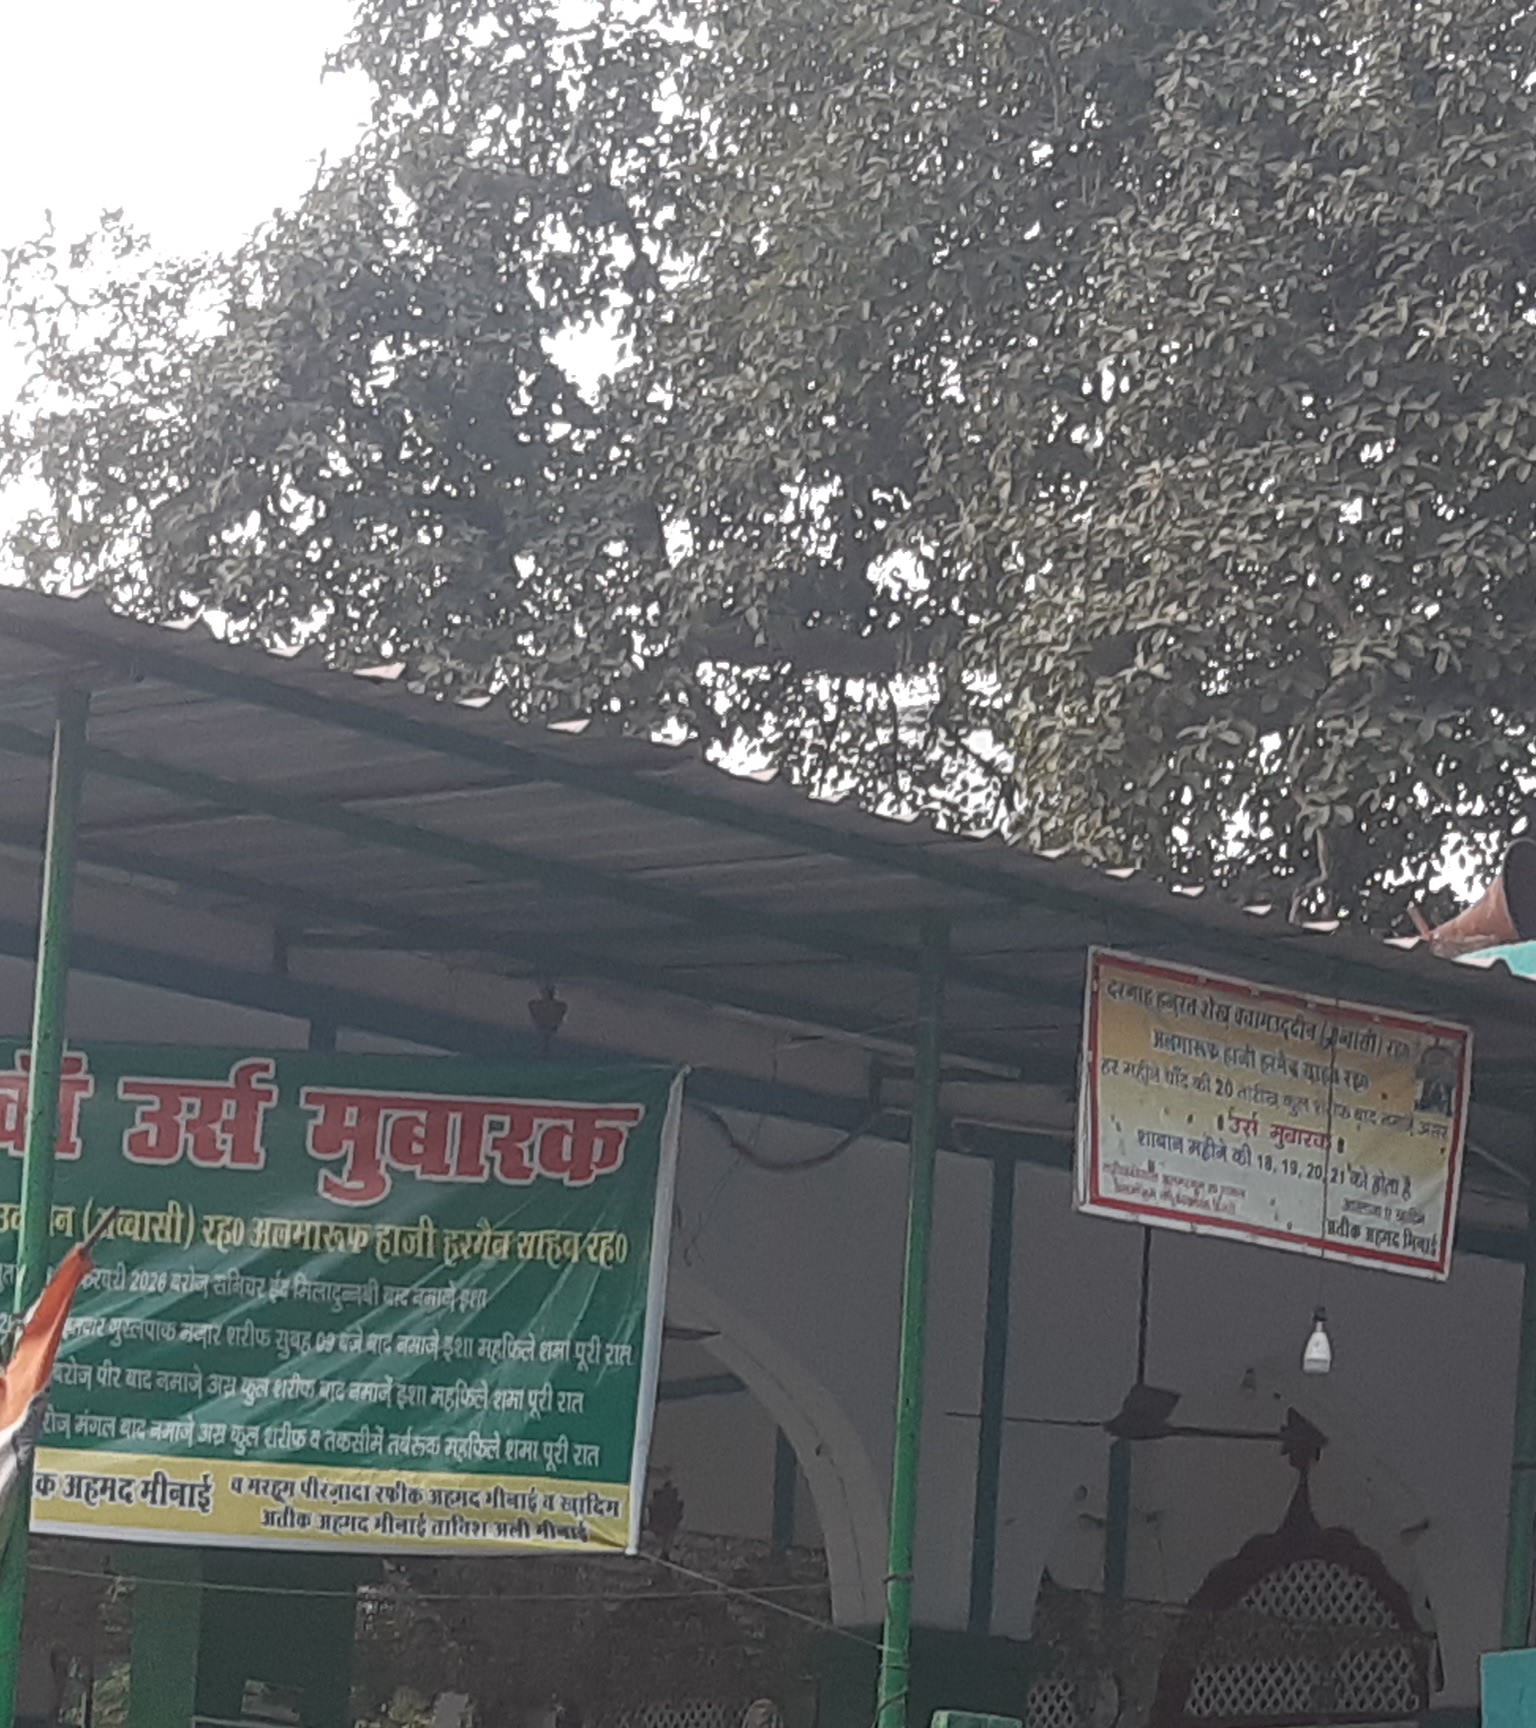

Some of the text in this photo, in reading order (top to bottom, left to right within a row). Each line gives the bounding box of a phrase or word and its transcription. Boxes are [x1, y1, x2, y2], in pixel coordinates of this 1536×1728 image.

[1215, 1076, 1234, 1099] 20
[117, 1057, 280, 1170] उर्स
[299, 1085, 647, 1207] मुबारक
[375, 1214, 437, 1264] हाजी
[129, 1269, 167, 1292] 2026
[573, 1333, 601, 1375] पूरी
[604, 1342, 633, 1367] रात
[527, 1382, 553, 1423] पूरी
[556, 1390, 585, 1414] रात
[75, 1408, 117, 1438] मंगल
[542, 1433, 569, 1472] पूरी
[572, 1442, 601, 1467] रात
[64, 1472, 136, 1508] अहमद
[140, 1470, 214, 1514] मीनाई
[428, 1485, 482, 1510] अहमद
[260, 1507, 313, 1531] अतीक
[317, 1513, 371, 1537] अहमद
[492, 1516, 532, 1541] अली
